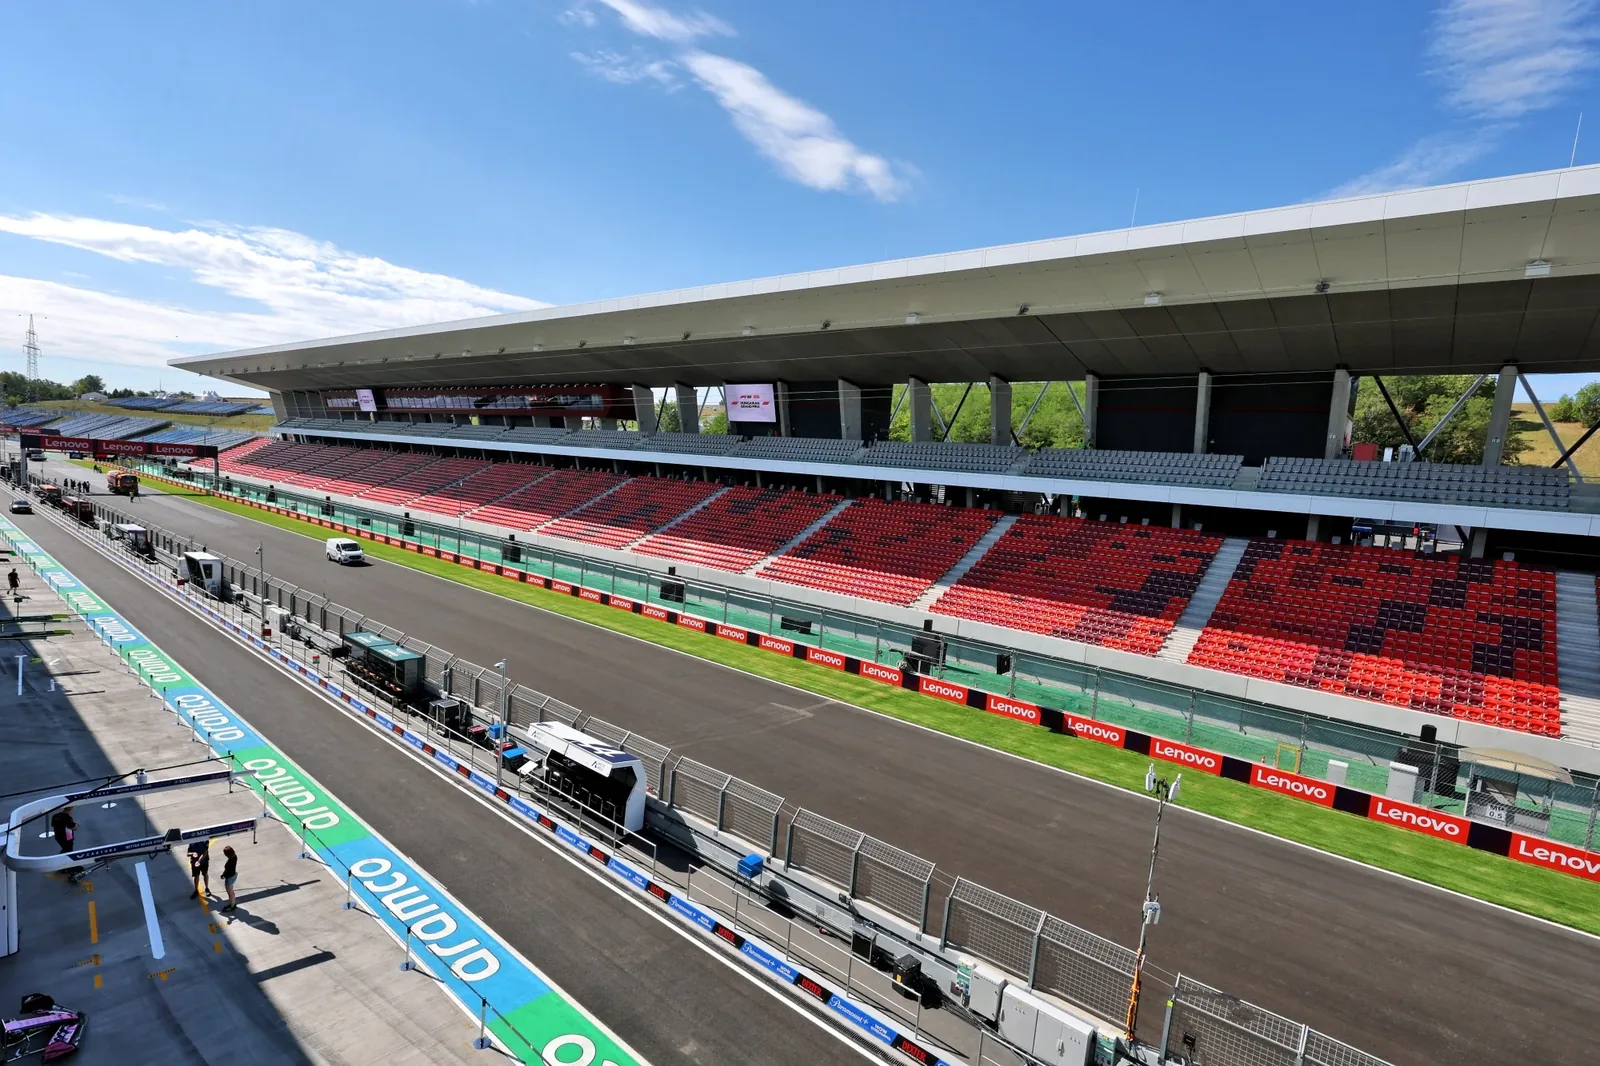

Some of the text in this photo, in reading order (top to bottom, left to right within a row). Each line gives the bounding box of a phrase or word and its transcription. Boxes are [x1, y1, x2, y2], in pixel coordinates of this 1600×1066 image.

[46, 439, 89, 448] Lenovo
[103, 442, 143, 452] Lenovo
[156, 446, 193, 454] Lenovo
[422, 546, 435, 556] Lenovo
[441, 552, 454, 560] Lenovo
[460, 558, 474, 566] Lenovo
[480, 563, 495, 572] Lenovo
[503, 569, 518, 578] Lenovo
[527, 576, 544, 586] Lenovo
[553, 582, 570, 592] Lenovo
[580, 588, 600, 600] Lenovo
[610, 598, 631, 609] Lenovo
[644, 606, 666, 618] Lenovo
[679, 615, 703, 629] Lenovo
[718, 626, 744, 640] Lenovo
[762, 637, 790, 652] Lenovo
[810, 650, 842, 666] Lenovo
[862, 661, 899, 682] Lenovo
[922, 680, 964, 700] Lenovo
[990, 699, 1036, 719] Lenovo
[174, 694, 244, 742] aramco
[1068, 718, 1120, 741] Lenovo
[1156, 742, 1216, 768] Lenovo
[1257, 770, 1327, 799] Lenovo
[244, 758, 340, 830] aramco
[1376, 802, 1460, 836] Lenovo
[1519, 840, 1600, 874] Lenov
[350, 858, 500, 982] aramco
[742, 942, 776, 968] Paramount+
[802, 978, 822, 997] DEXTER
[830, 996, 868, 1025] Paramount+
[902, 1040, 926, 1062] DEXTER
